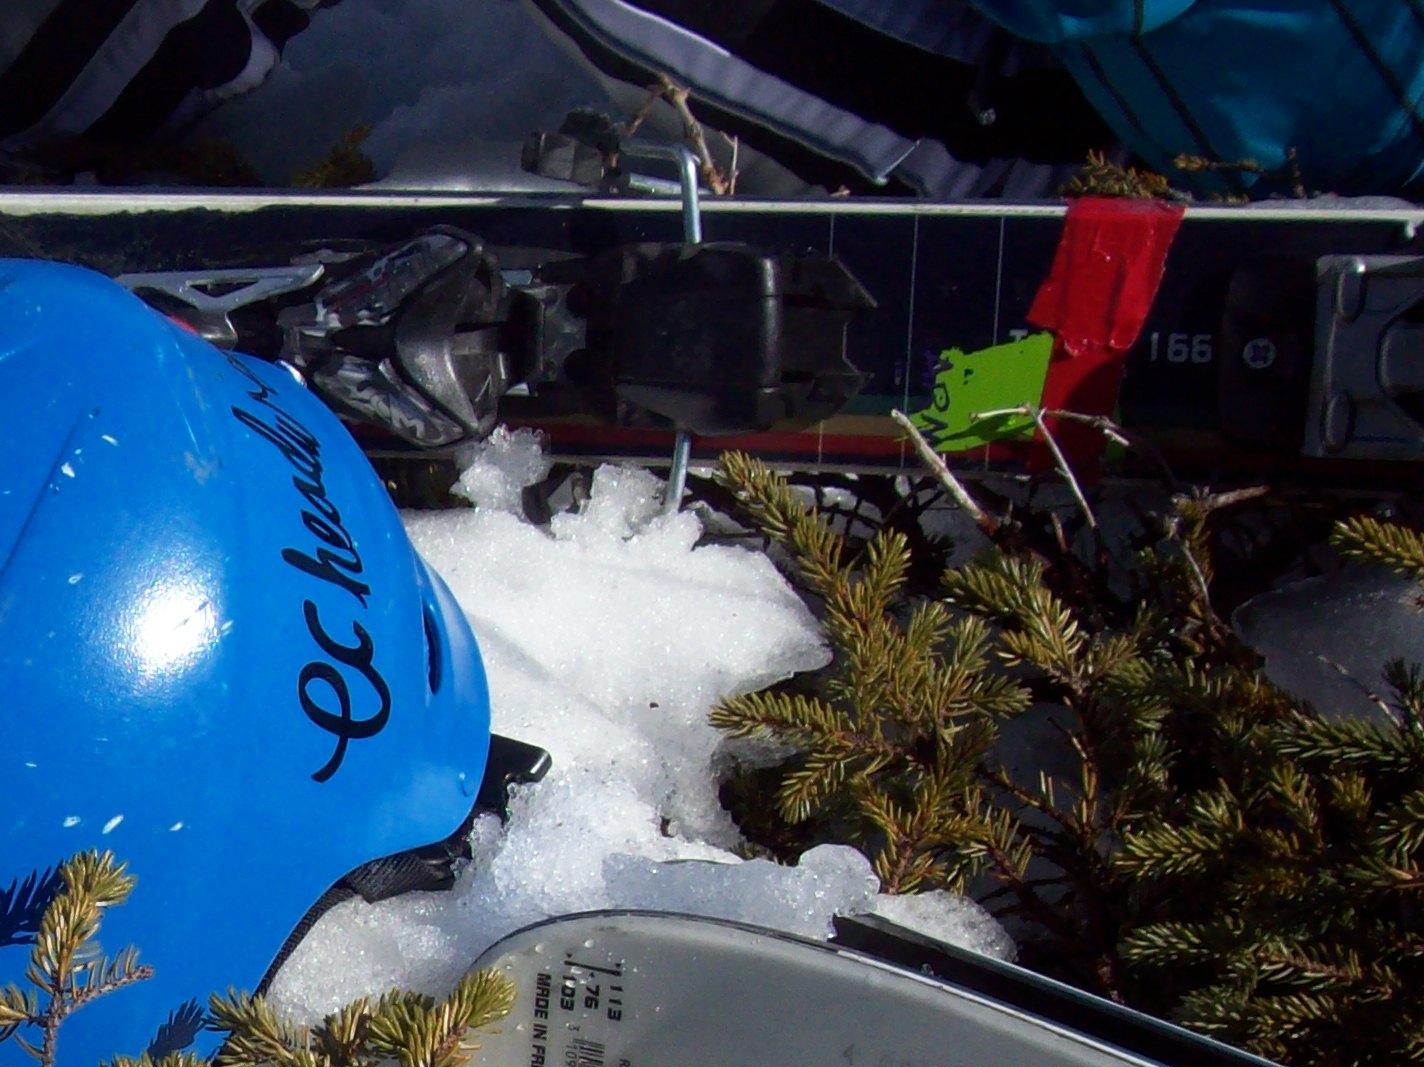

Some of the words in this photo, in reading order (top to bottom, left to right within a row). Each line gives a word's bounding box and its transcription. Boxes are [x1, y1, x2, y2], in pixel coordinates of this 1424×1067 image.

[1148, 330, 1214, 364] 166
[534, 972, 552, 1020] MADE
[560, 974, 578, 1012] 103
[584, 984, 601, 1010] 76
[607, 984, 624, 1022] 113
[533, 1023, 548, 1041] IN
